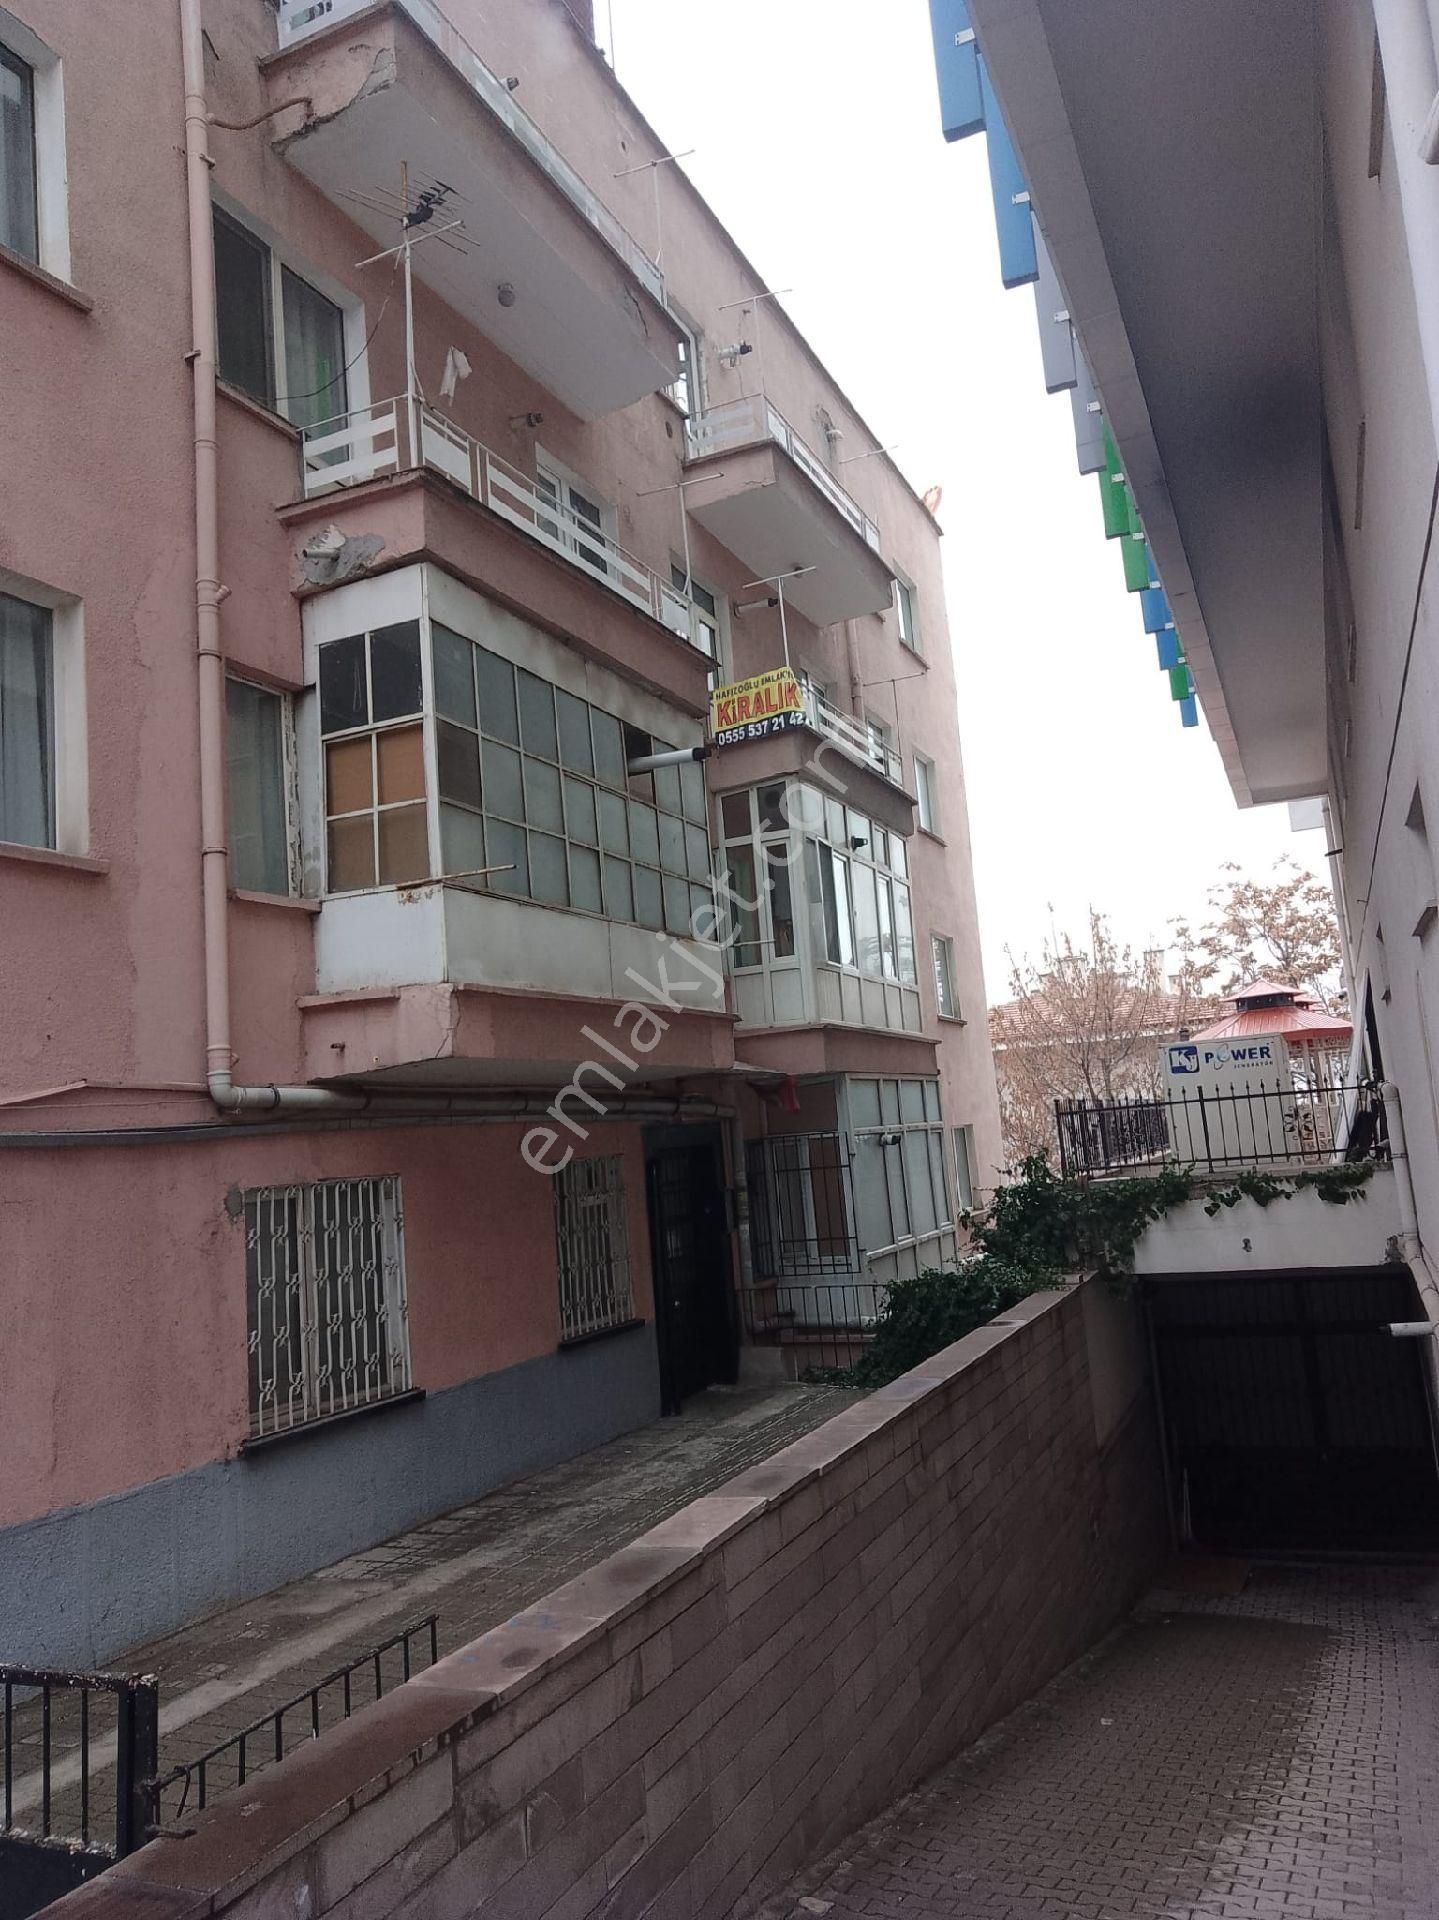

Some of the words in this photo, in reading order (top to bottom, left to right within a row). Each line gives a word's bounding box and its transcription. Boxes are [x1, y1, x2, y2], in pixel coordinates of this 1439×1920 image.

[718, 729, 746, 746] 0555
[748, 721, 768, 737] 537
[772, 715, 785, 731] 21
[789, 711, 805, 726] 42
[1204, 1044, 1272, 1066] POWER
